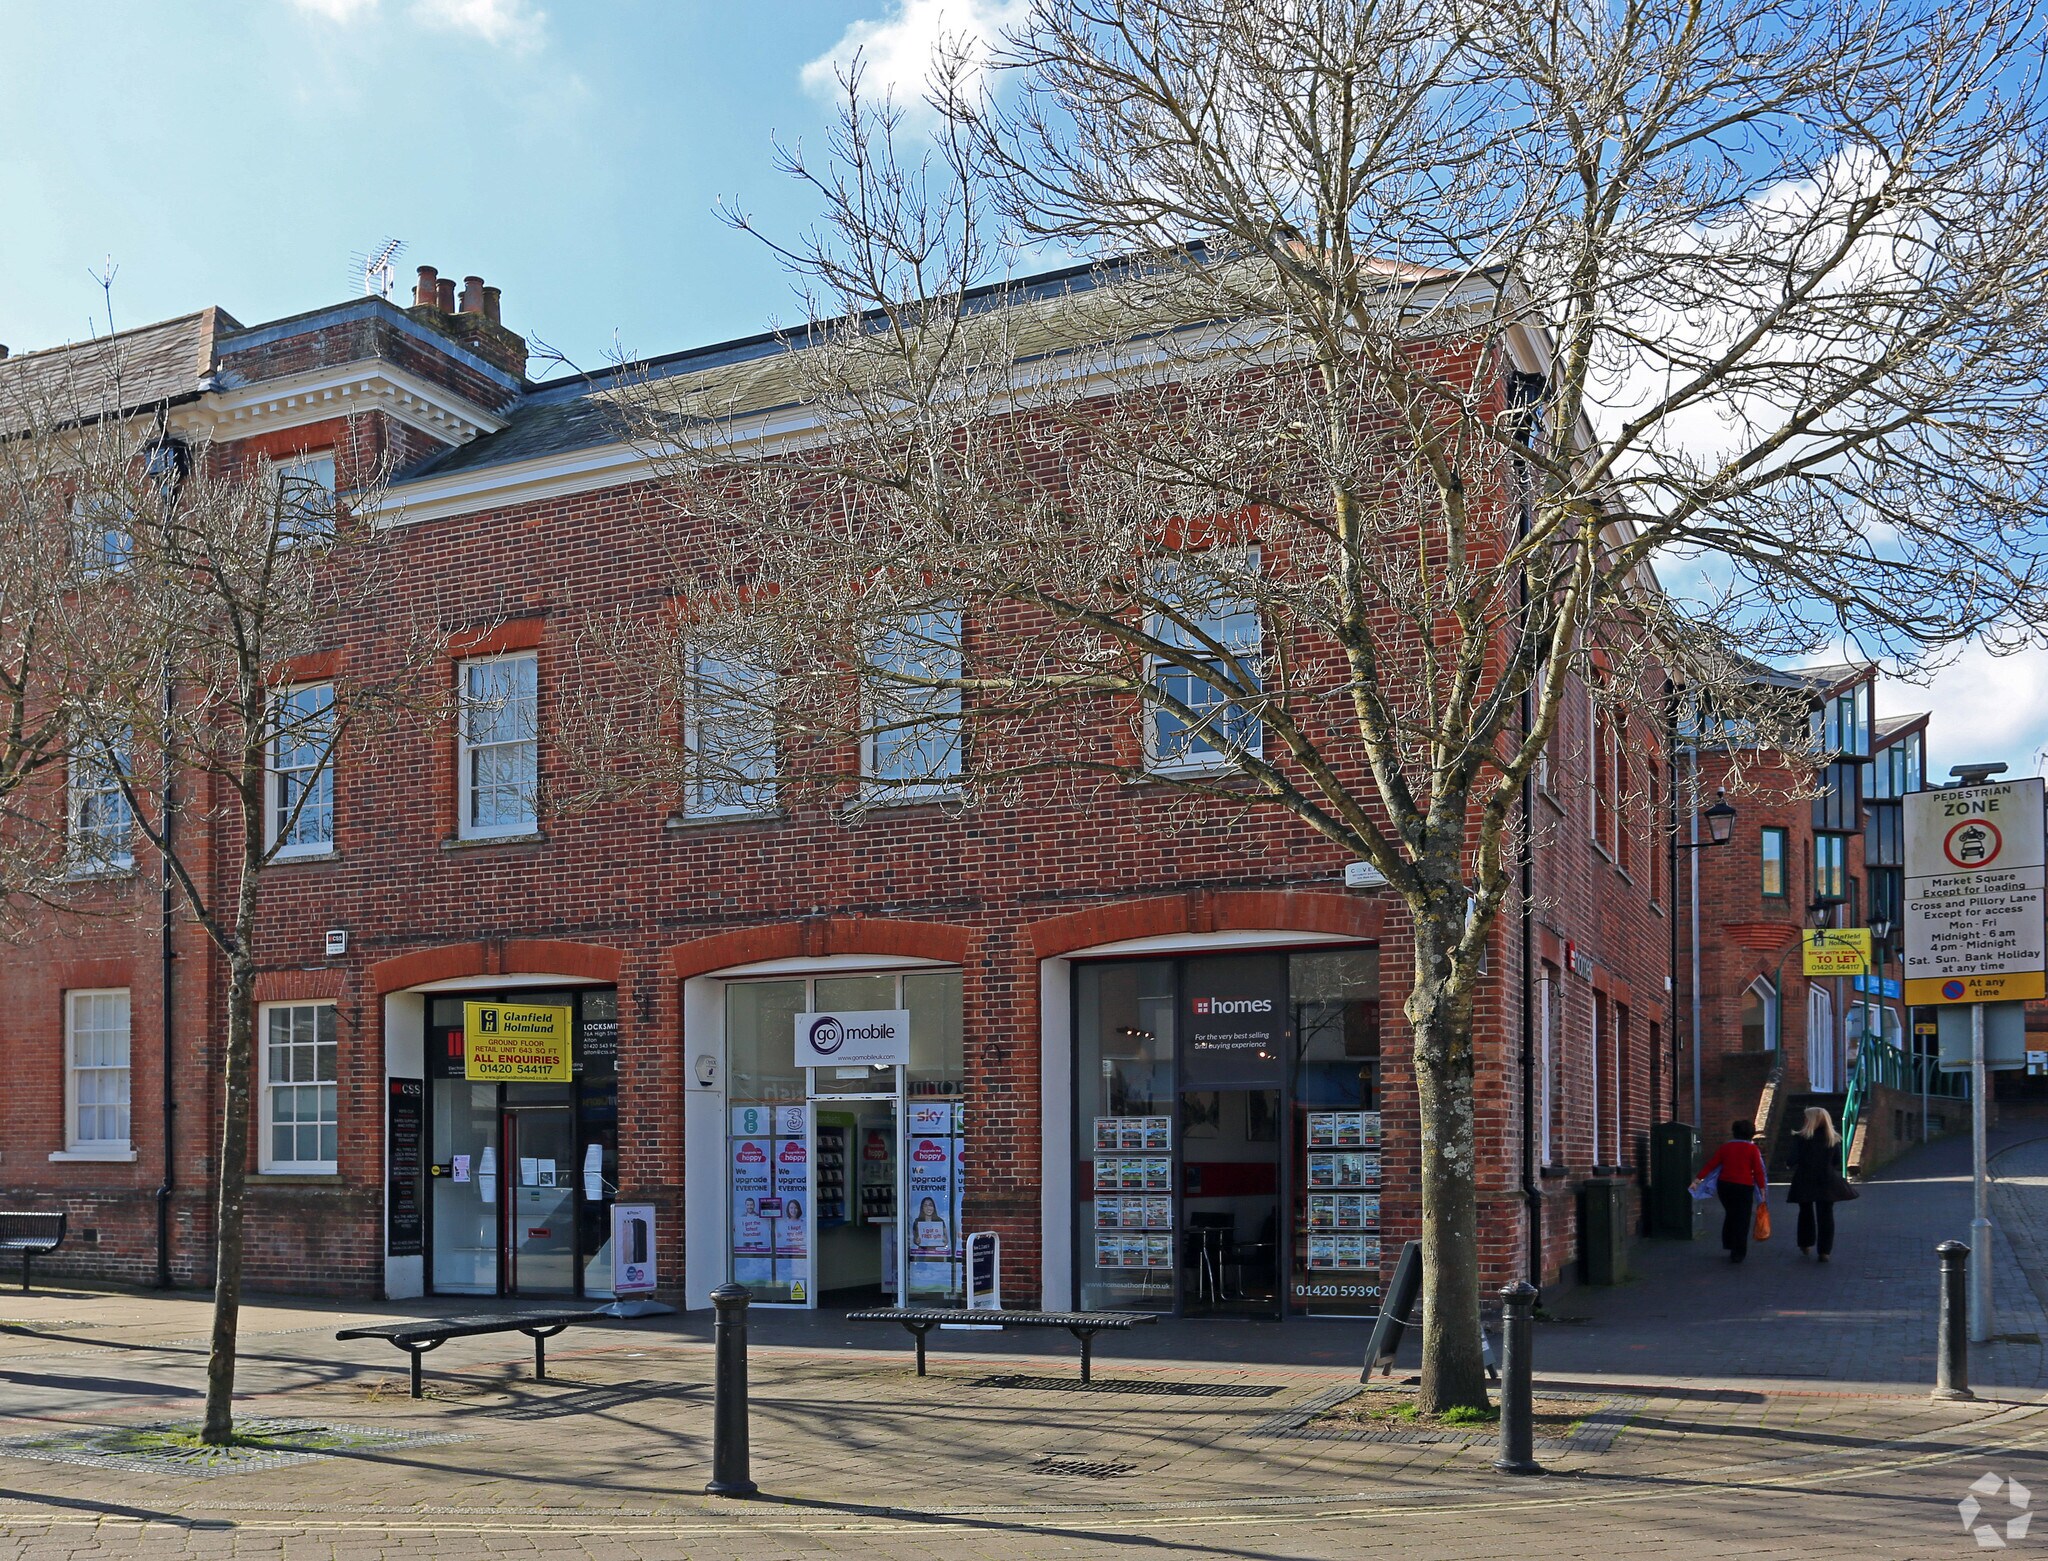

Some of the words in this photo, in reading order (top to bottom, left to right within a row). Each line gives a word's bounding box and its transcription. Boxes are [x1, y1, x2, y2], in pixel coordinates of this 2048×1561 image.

[1934, 786, 2011, 802] PEDESTRIAN
[1944, 799, 2000, 816] ZONE
[1932, 876, 1971, 887] Market
[1976, 874, 2016, 884] Square
[1923, 888, 1961, 898] Except
[1964, 886, 1980, 894] for
[1984, 882, 2026, 893] loading
[1910, 902, 1942, 911] Cross
[1945, 899, 1965, 908] and
[1970, 896, 2006, 906] Pillory
[2010, 894, 2037, 903] Lane
[1924, 910, 1962, 920] Except
[1985, 905, 2023, 914] access
[1949, 921, 1973, 929] Mon
[1932, 931, 1980, 942] Midnight
[1940, 944, 1957, 952] pm
[1966, 938, 2016, 949] Midnight
[1909, 956, 1930, 966] Sat.
[1935, 955, 1960, 964] Sun.
[1965, 952, 1993, 961] Bank
[1997, 950, 2040, 960] Holiday
[1957, 964, 1976, 973] any
[1980, 962, 2005, 971] time
[1968, 979, 1983, 987] At
[1985, 979, 2006, 987] any
[1975, 988, 2000, 997] time
[1211, 997, 1272, 1014] homes
[504, 1012, 553, 1022] Glanfield
[504, 1023, 554, 1033] Holmlund
[846, 1024, 895, 1040] mobile
[817, 1029, 836, 1044] go
[1231, 1041, 1266, 1049] experience
[474, 1054, 494, 1062] ALL
[498, 1055, 560, 1064] ENQUIRIES
[480, 1064, 512, 1073] 01420
[517, 1065, 553, 1074] 544117
[402, 1084, 421, 1094] CSS
[916, 1108, 944, 1125] sky
[912, 1176, 947, 1184] upgrade
[1296, 1285, 1337, 1296] 01420
